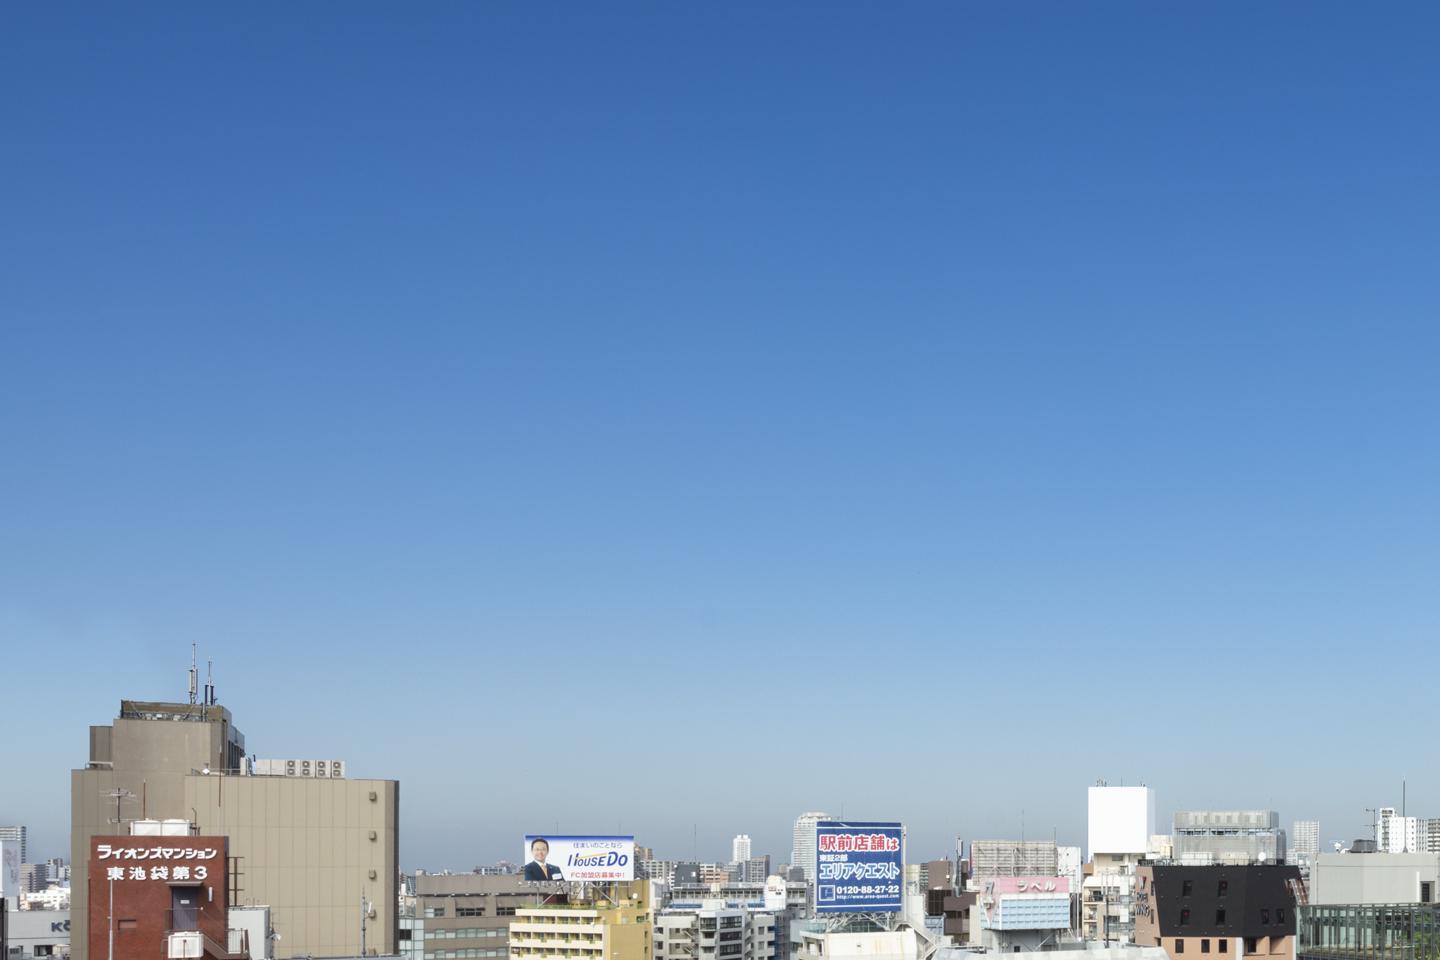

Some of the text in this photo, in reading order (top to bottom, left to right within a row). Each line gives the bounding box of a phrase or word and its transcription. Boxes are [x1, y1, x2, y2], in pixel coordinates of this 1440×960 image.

[573, 842, 623, 850] 住まいのことなら
[819, 834, 900, 852] 駅前店舗は
[97, 844, 217, 860] ライオンズマンション
[107, 866, 208, 881] 東池袋第3
[819, 862, 900, 880] エリアクエスト
[836, 885, 899, 895] 0120-88-27-22
